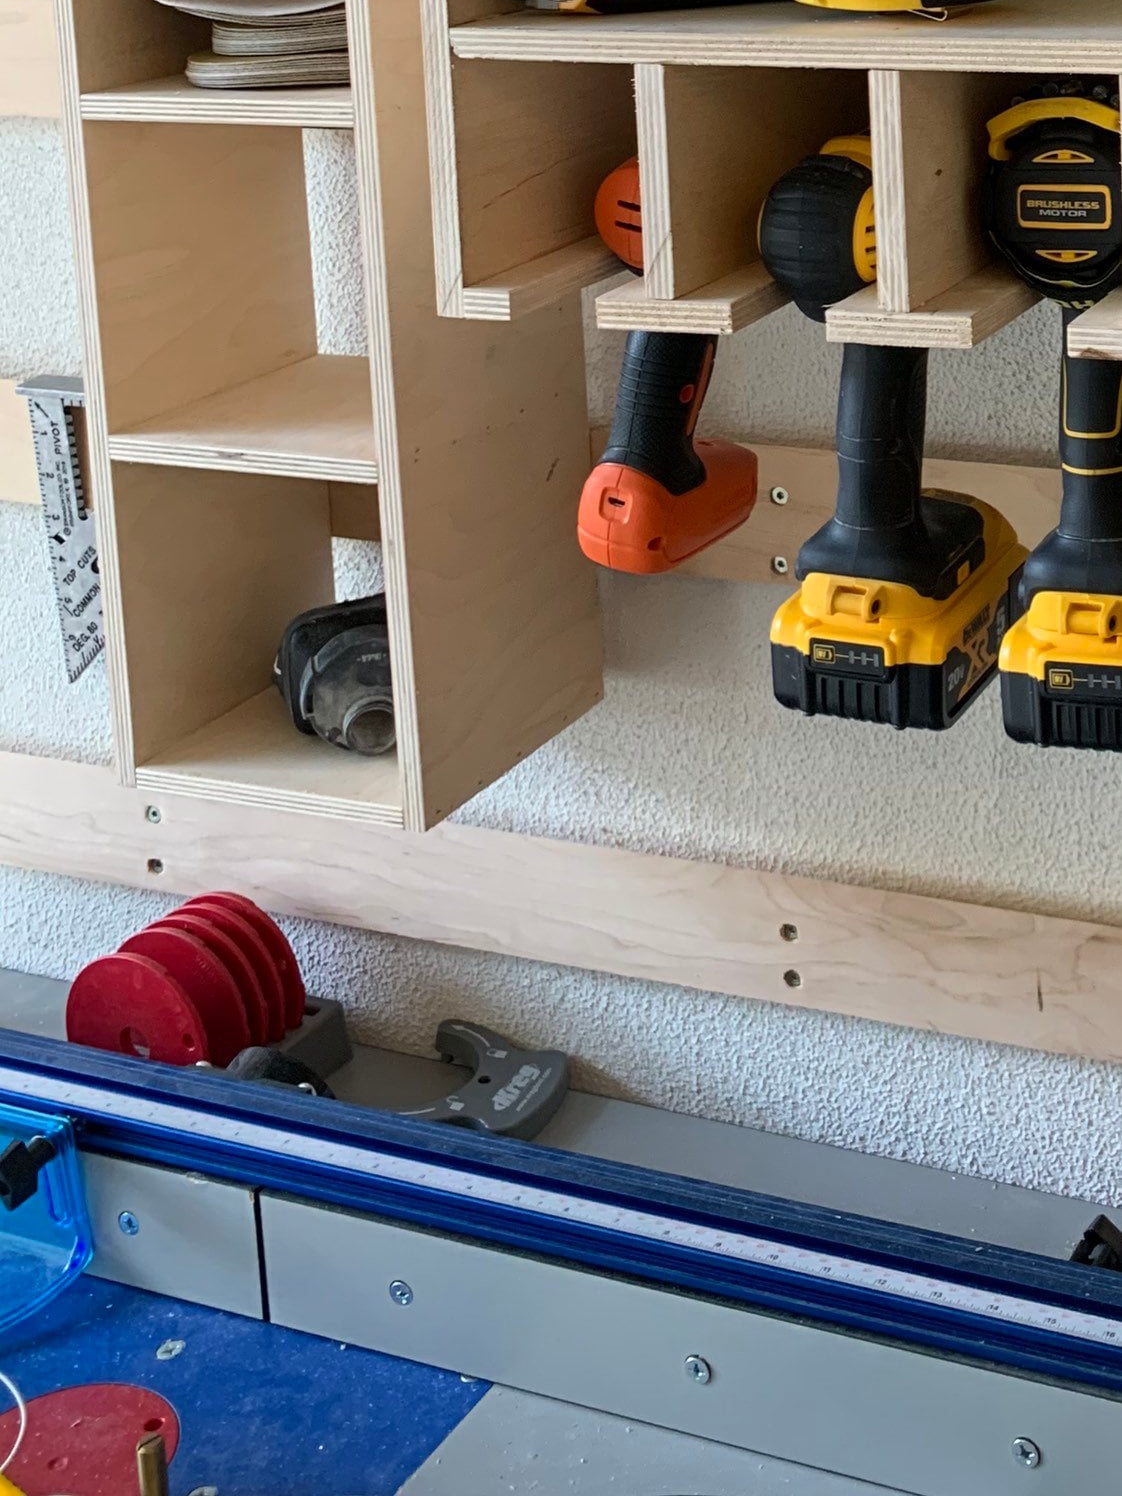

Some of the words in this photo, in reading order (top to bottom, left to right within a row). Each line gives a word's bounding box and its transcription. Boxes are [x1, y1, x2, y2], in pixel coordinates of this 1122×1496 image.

[1026, 199, 1100, 210] BRUSHLESS
[1039, 209, 1087, 217] MOTOR
[50, 420, 62, 456] PIVOT
[62, 568, 77, 586] TOP
[77, 545, 97, 570] CUTS
